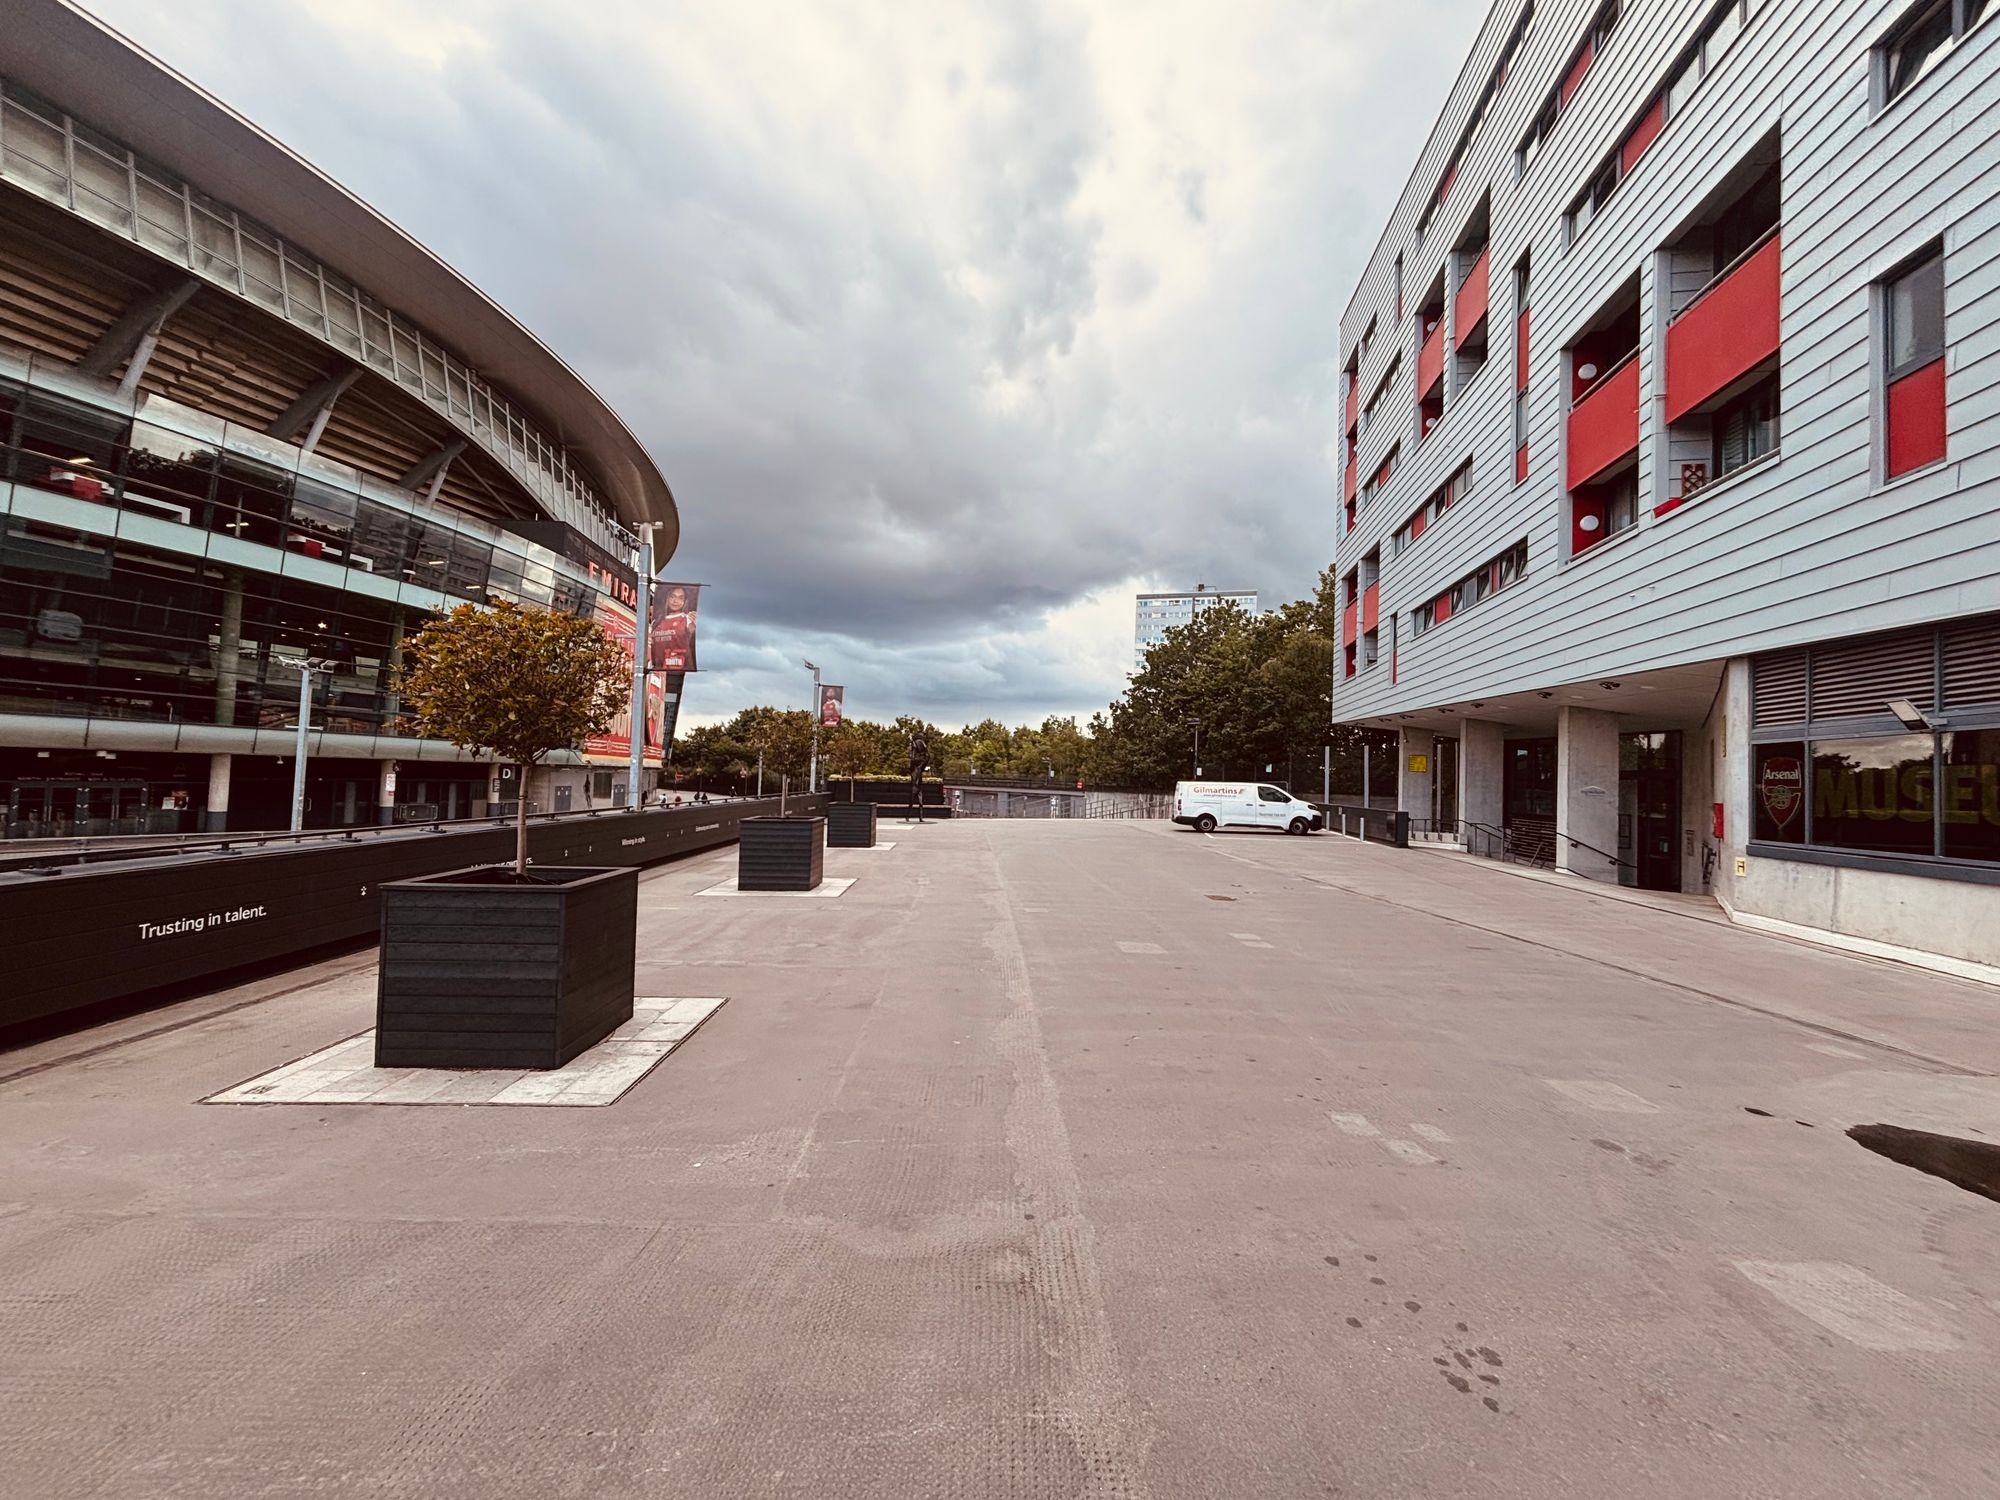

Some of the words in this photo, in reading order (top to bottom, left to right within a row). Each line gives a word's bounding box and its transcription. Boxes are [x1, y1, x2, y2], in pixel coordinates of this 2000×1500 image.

[502, 768, 512, 779] D
[1764, 768, 1799, 781] Arsenal
[1193, 786, 1238, 795] Gilmartins
[139, 916, 205, 939] Trusting
[208, 912, 221, 926] in
[225, 905, 267, 922] talent.
